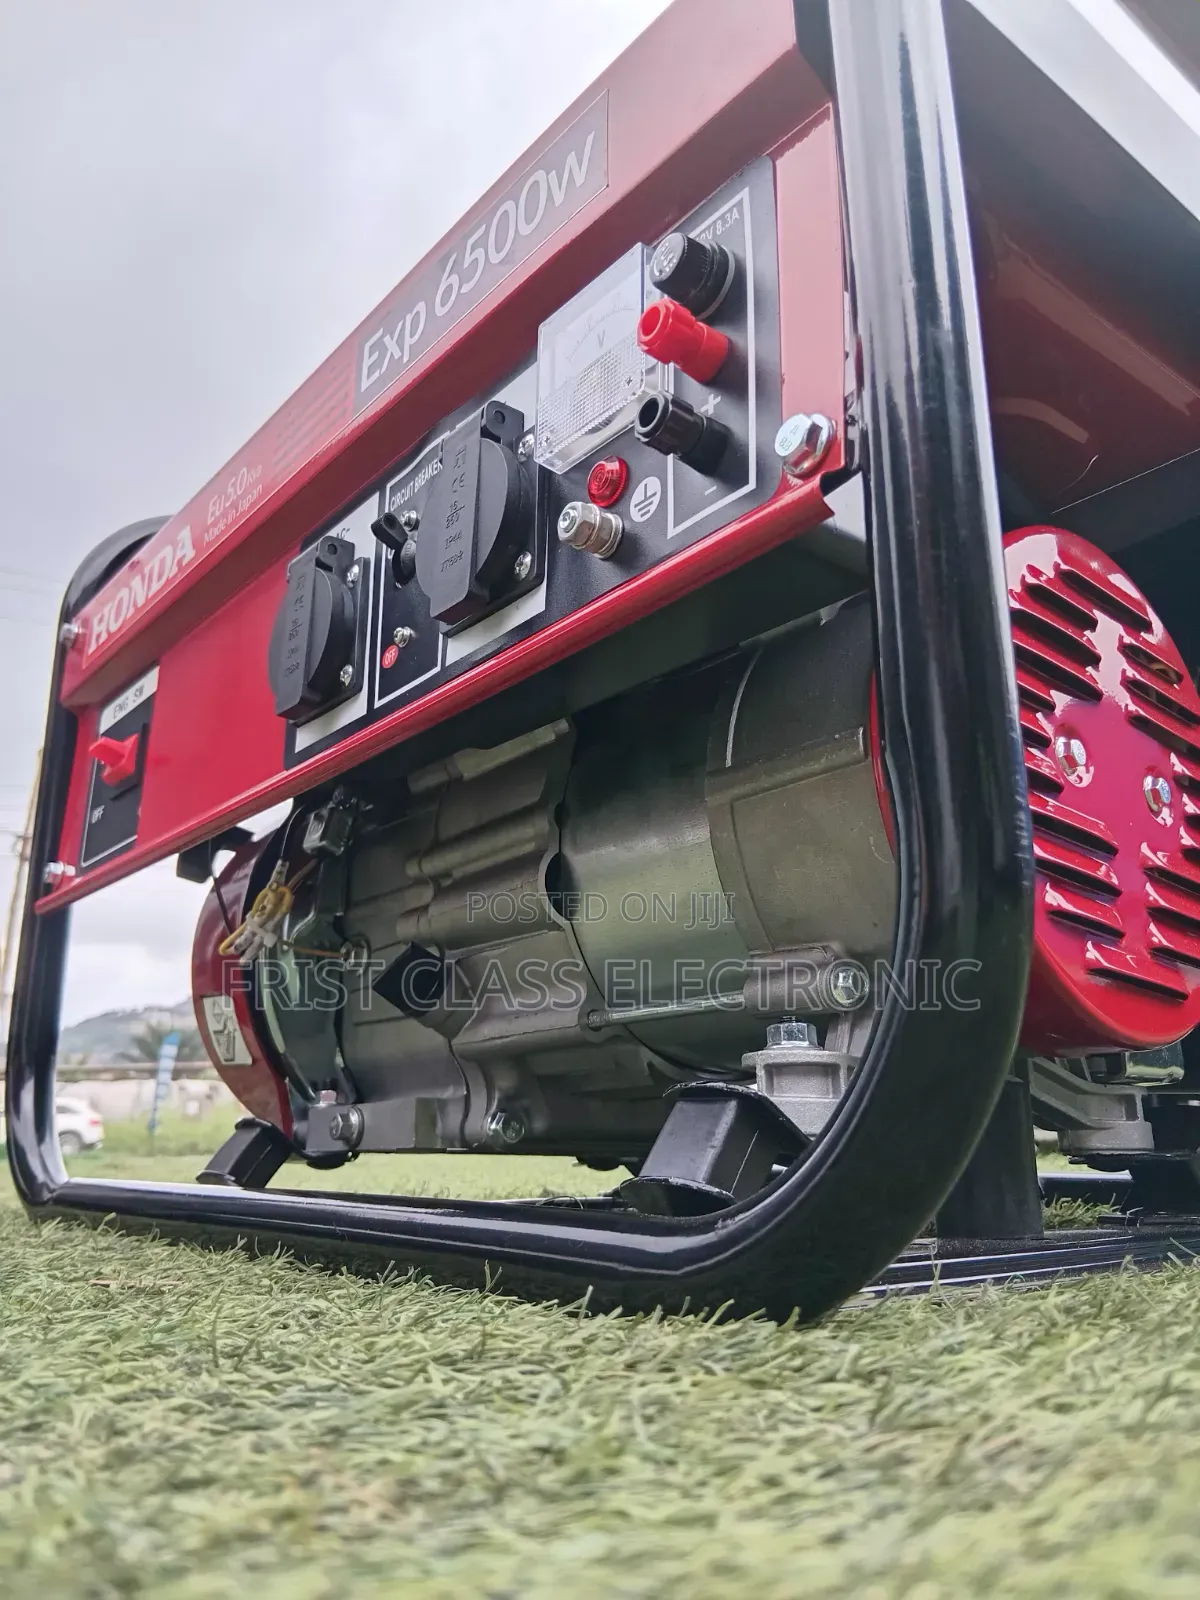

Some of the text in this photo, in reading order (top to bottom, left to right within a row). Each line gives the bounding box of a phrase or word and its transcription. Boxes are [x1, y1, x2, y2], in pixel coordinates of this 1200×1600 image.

[716, 207, 740, 235] 8.3A
[360, 301, 426, 392] Exp
[390, 458, 443, 511] CIRCUIT BREAKER
[203, 517, 227, 547] Made
[236, 484, 263, 517] Japan
[87, 525, 196, 656] HONDA
[384, 648, 396, 665] OFF
